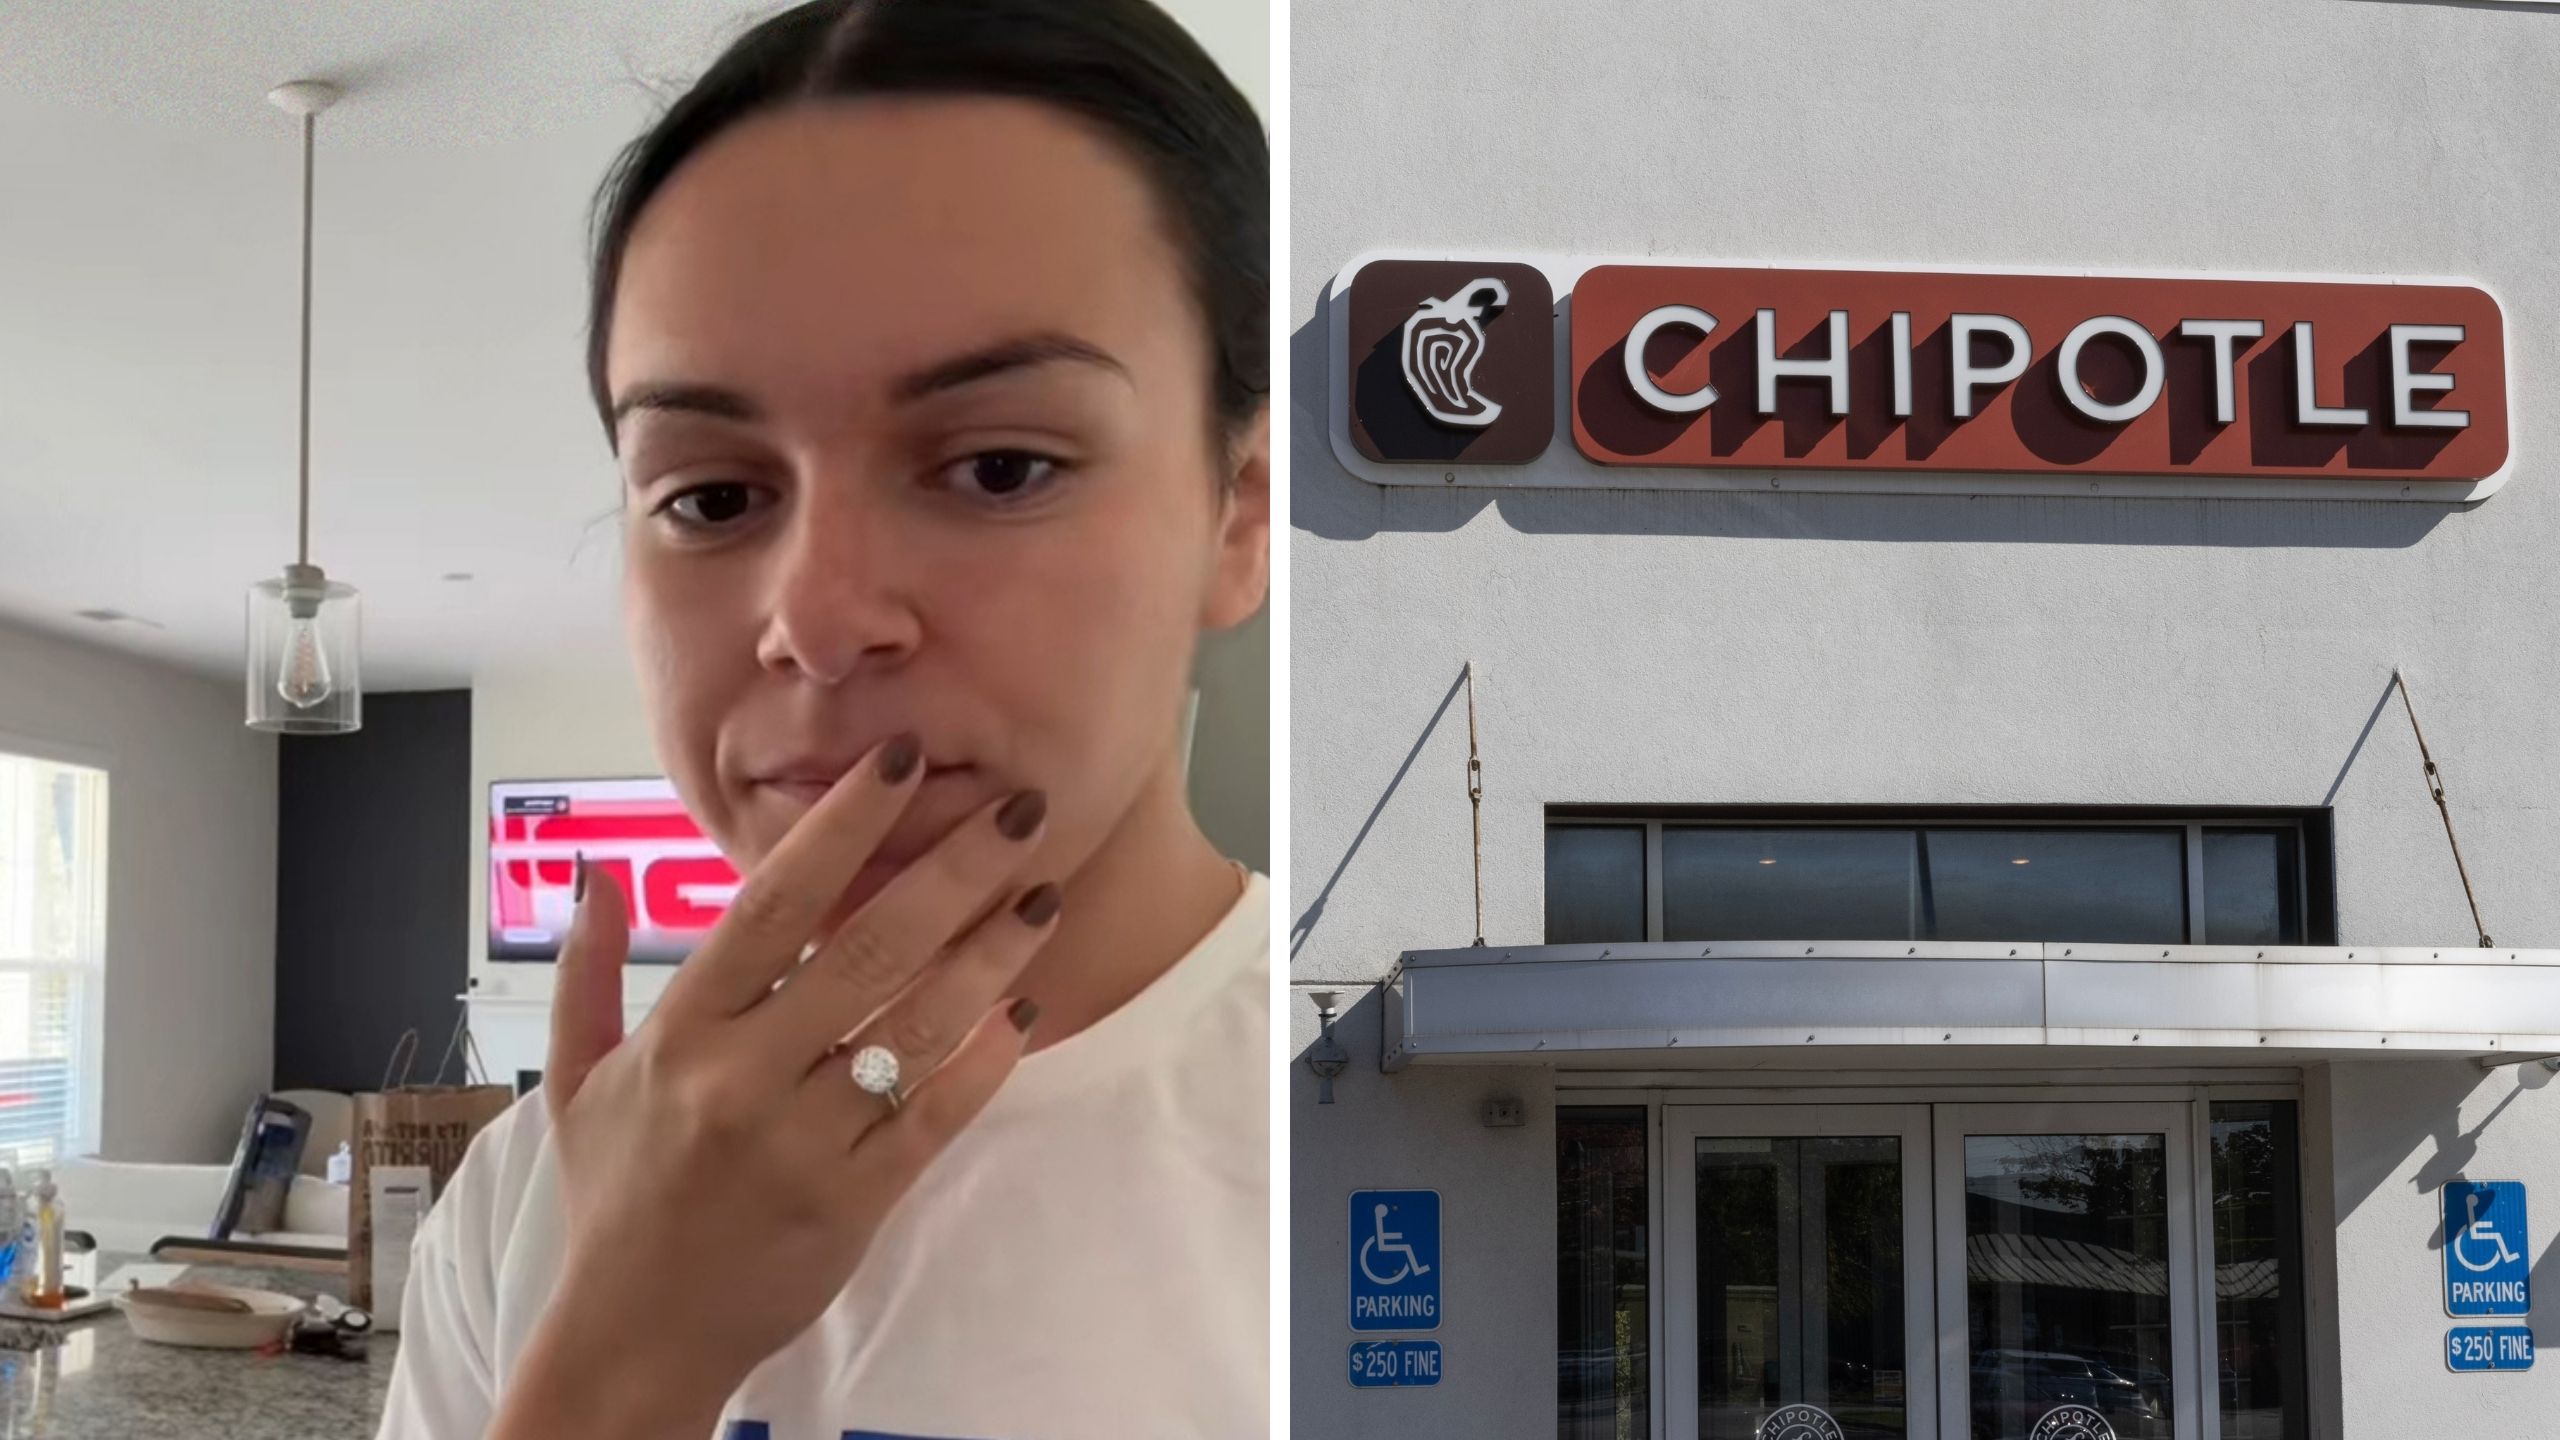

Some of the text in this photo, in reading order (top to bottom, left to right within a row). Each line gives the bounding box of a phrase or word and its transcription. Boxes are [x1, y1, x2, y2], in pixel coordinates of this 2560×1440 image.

[1624, 304, 2471, 428] CHIPOTLE
[2452, 1281, 2526, 1303] PARKING
[1356, 1295, 1435, 1318] PARKING
[2451, 1336, 2532, 1361] $250 FINE
[1352, 1351, 1439, 1378] $250 FINE
